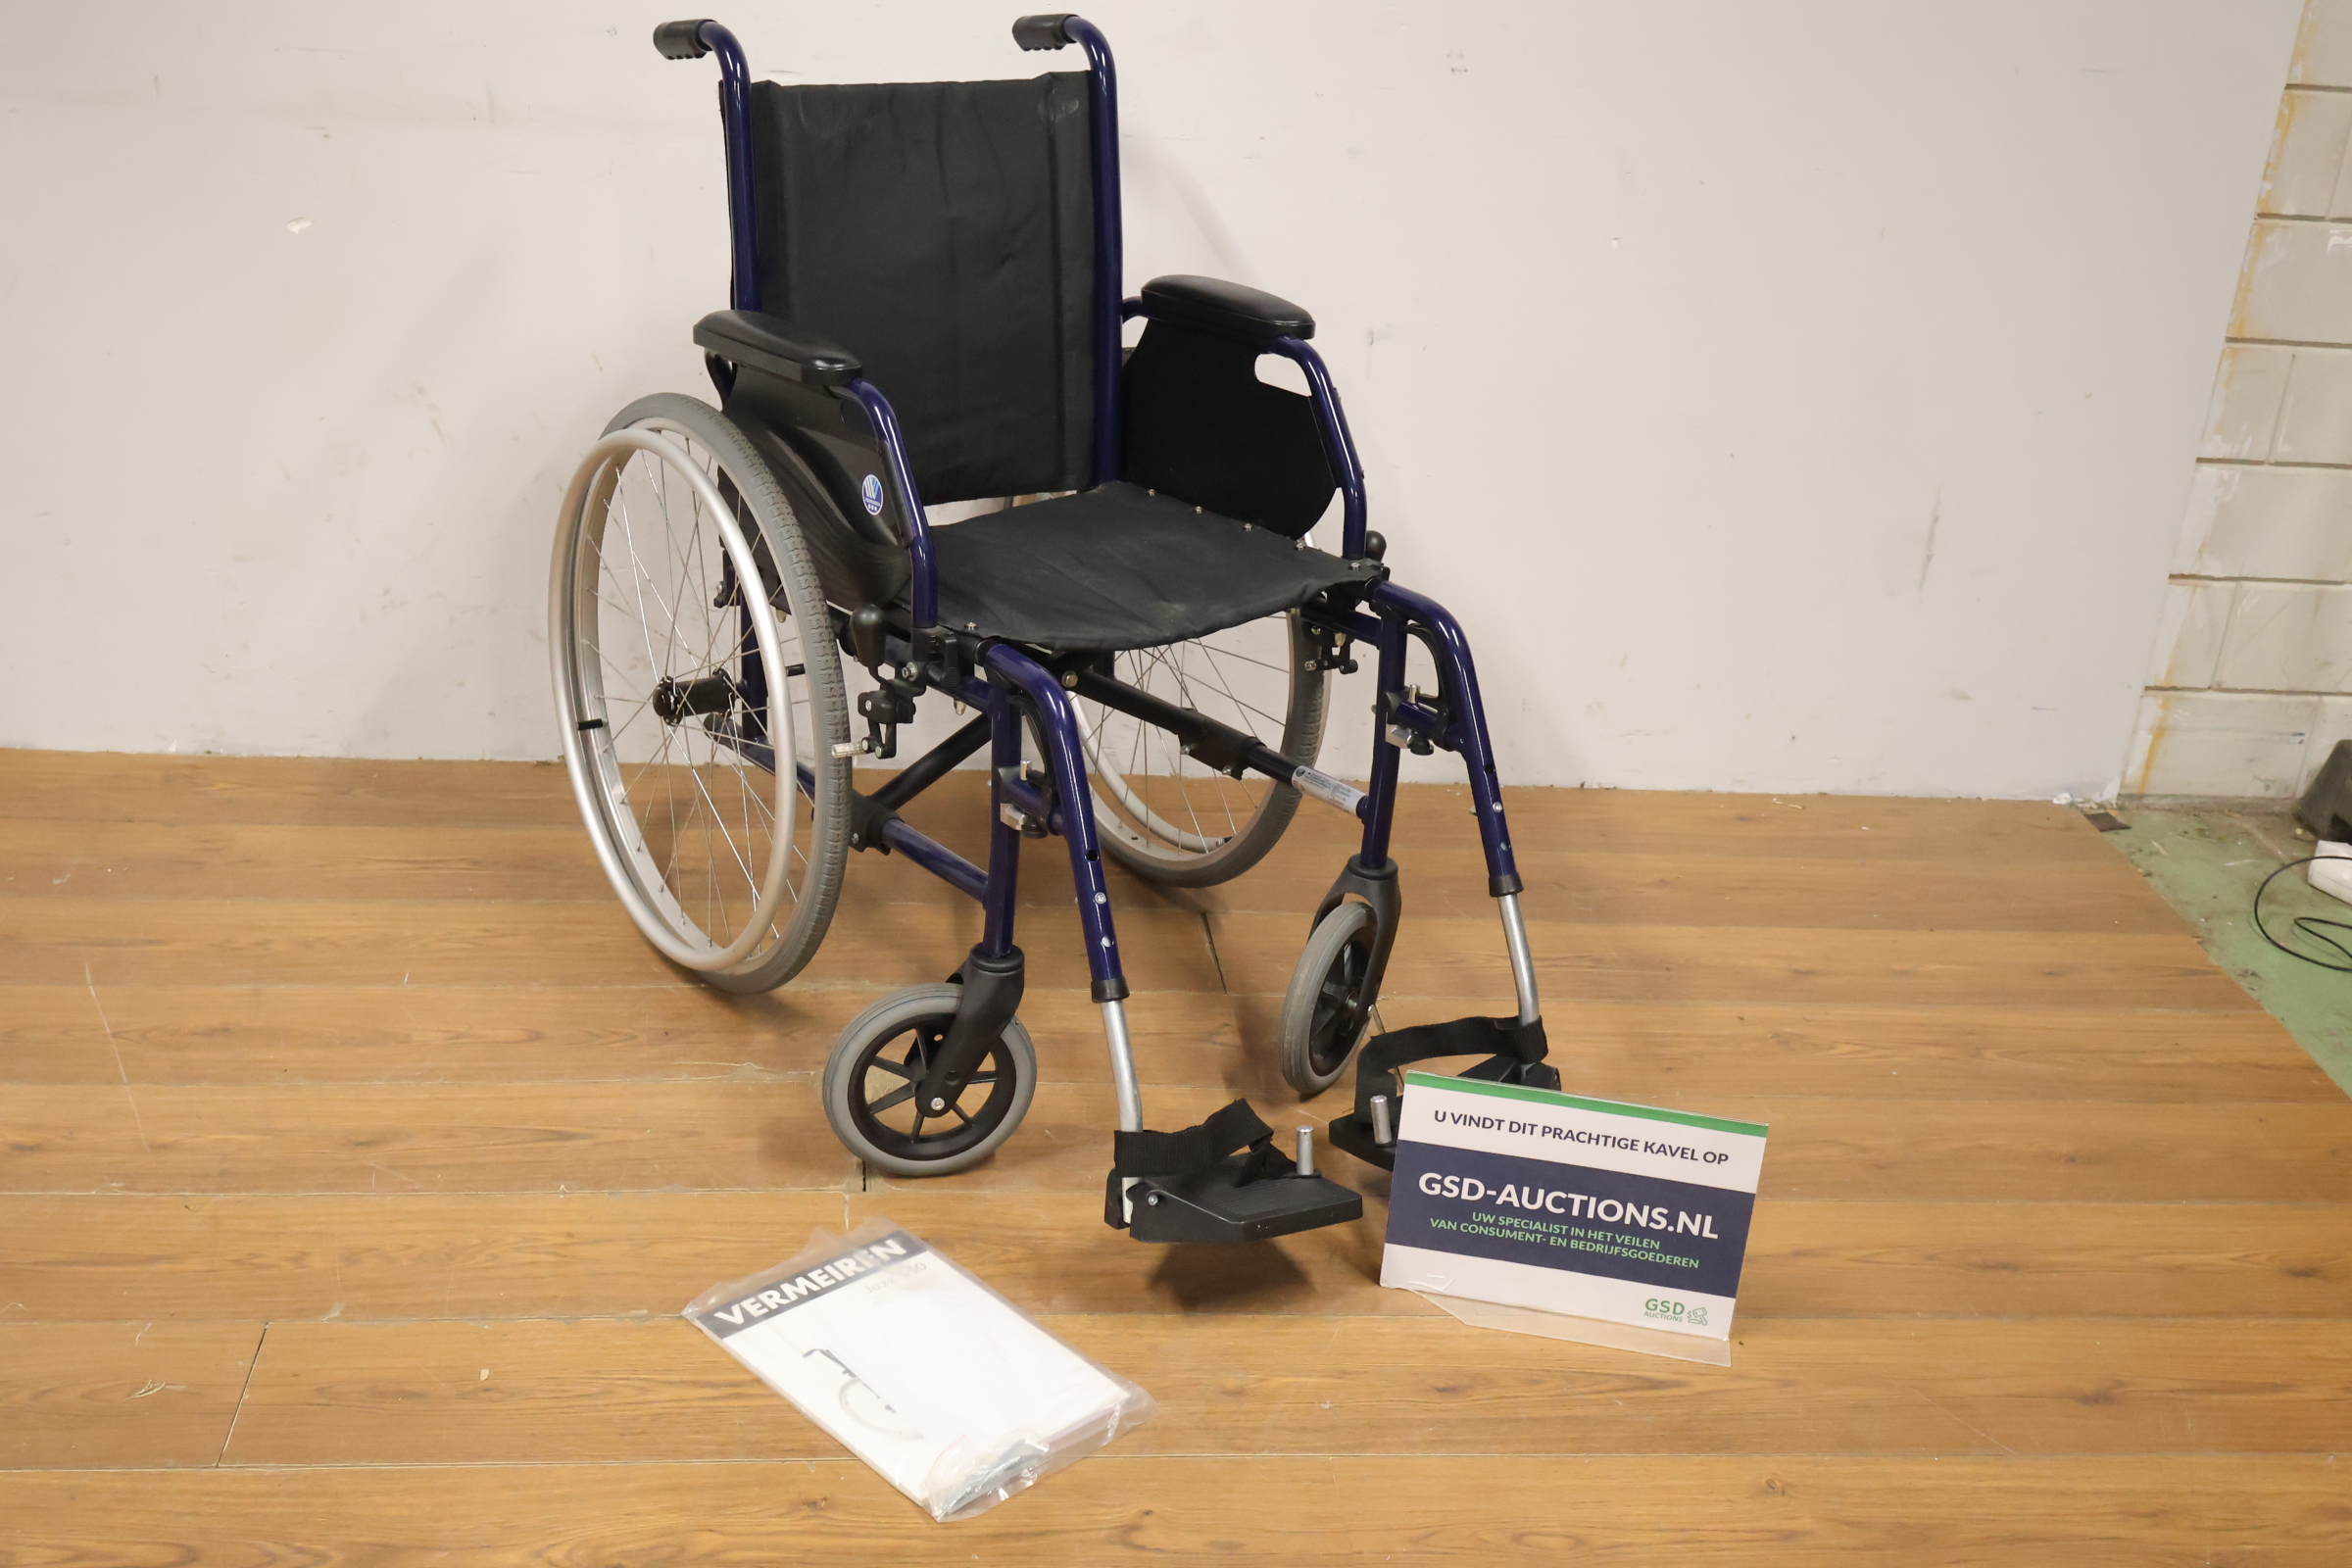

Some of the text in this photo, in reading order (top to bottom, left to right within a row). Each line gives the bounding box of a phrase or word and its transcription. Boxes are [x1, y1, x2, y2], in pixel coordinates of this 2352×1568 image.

[1434, 1109, 1729, 1165] U VINDT DIT PRACHTIGE KAVEL OP
[1418, 1172, 1719, 1240] GSD-AUCTIONS.NL
[1472, 1211, 1660, 1250] UW SPECIALIST IN HET VEILEN
[1430, 1218, 1699, 1269] VAN CONSUMENT- EN BEDRIJFSGOEDEREN
[713, 1239, 907, 1325] VERMEIREN
[1644, 1298, 1686, 1315] GSD
[1643, 1311, 1683, 1323] AUCTIONS
